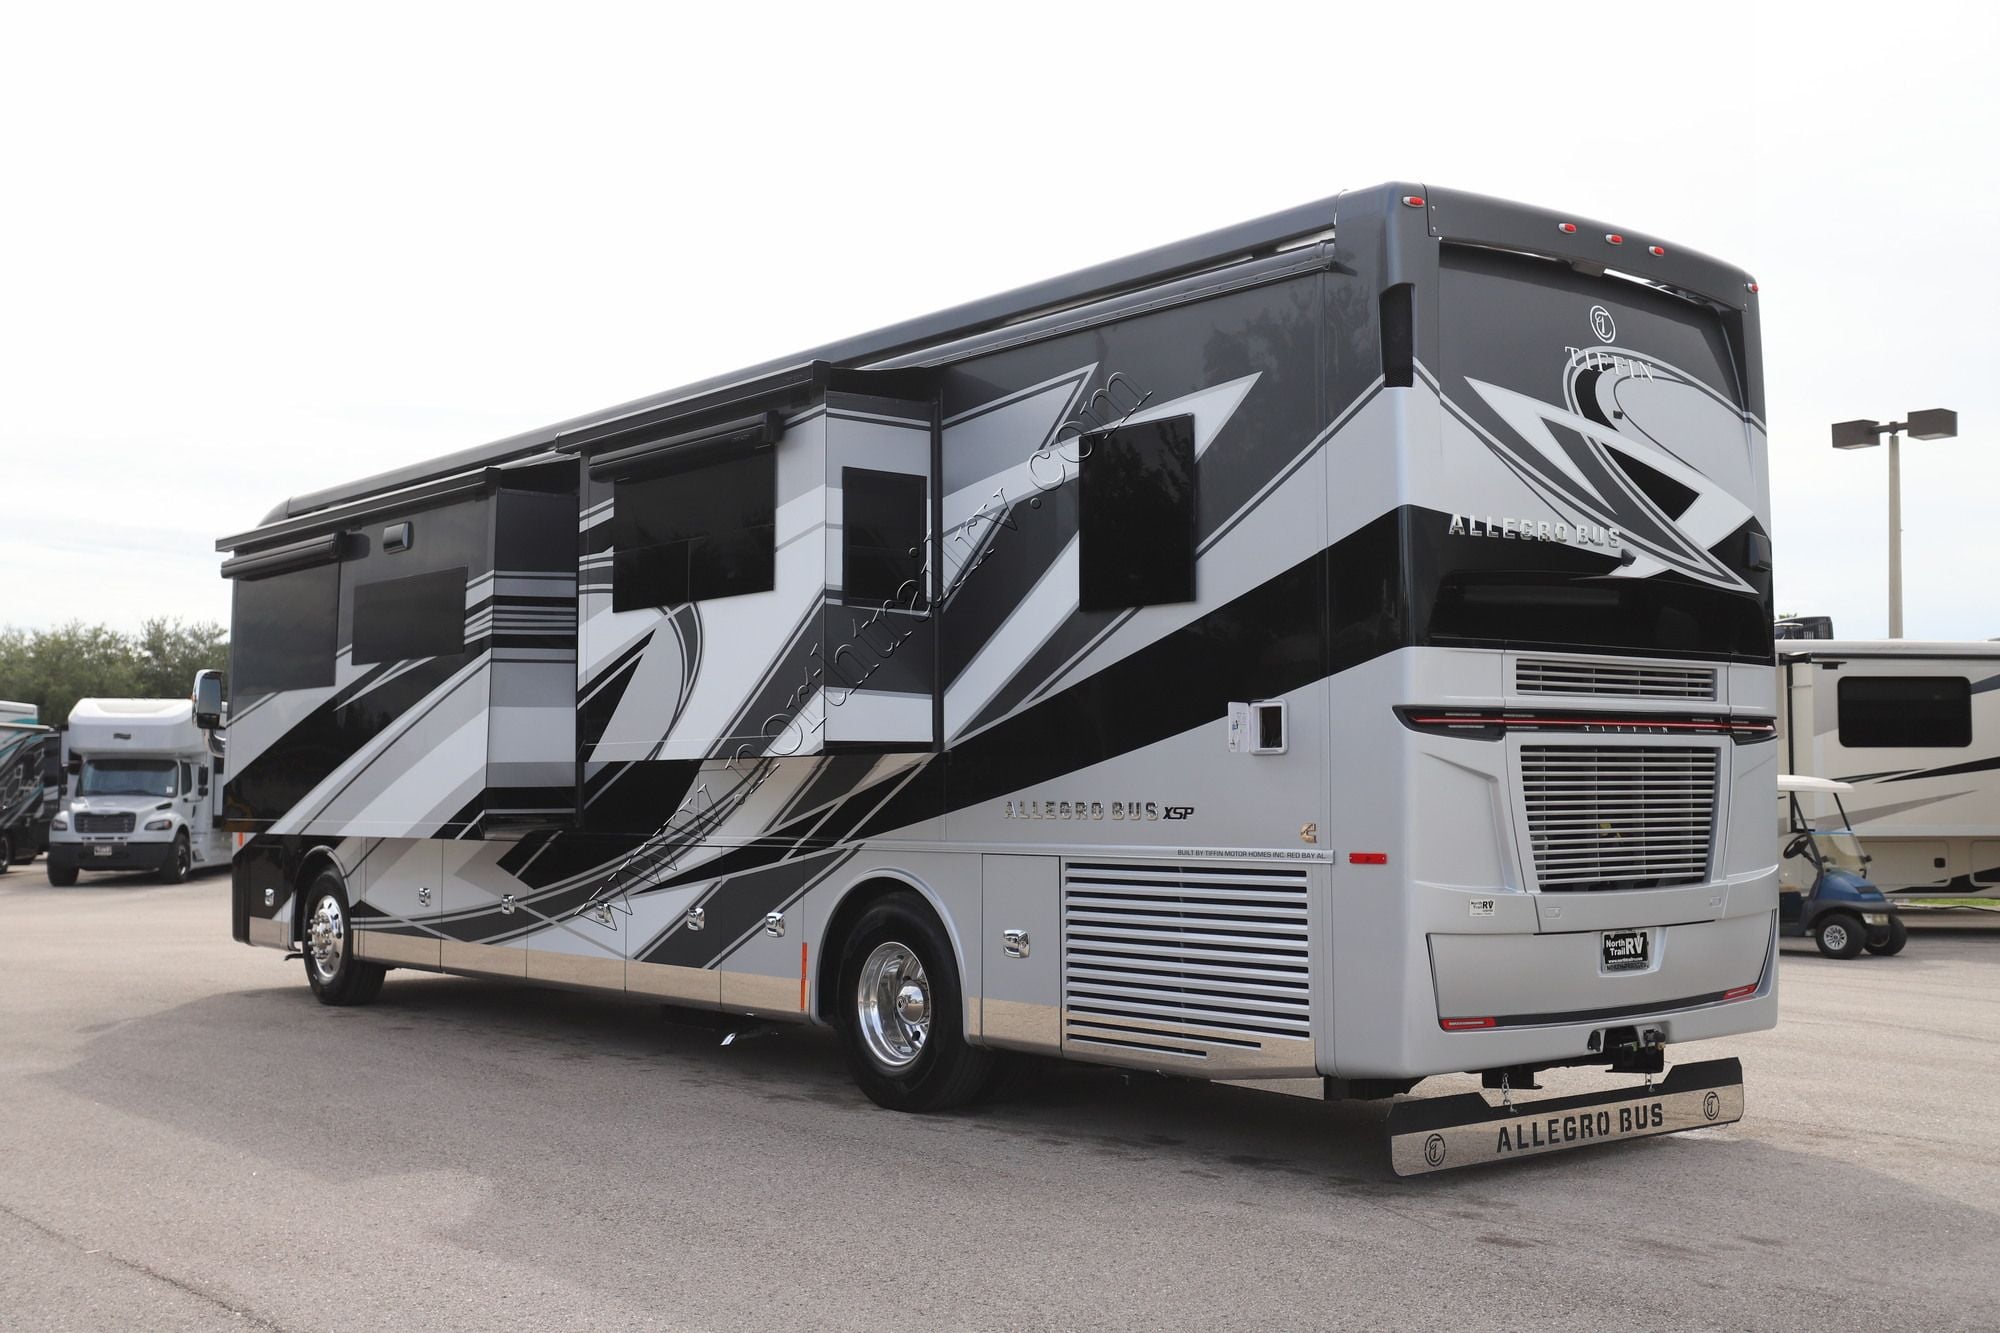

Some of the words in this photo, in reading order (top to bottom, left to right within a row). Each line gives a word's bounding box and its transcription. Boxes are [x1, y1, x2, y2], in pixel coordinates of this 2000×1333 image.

[1564, 346, 1655, 384] TIFFIN
[1448, 513, 1568, 543] ALLEGRO
[1576, 523, 1622, 549] BUS
[1003, 800, 1105, 821] ALLEGRO
[1111, 801, 1159, 821] BUS
[1162, 806, 1196, 820] XSP
[1195, 849, 1204, 857] BY
[1286, 851, 1301, 859] RED
[1301, 852, 1315, 860] BAY
[1605, 938, 1626, 948] North
[1625, 936, 1644, 955] RV
[1609, 947, 1626, 956] Trail
[1496, 1111, 1610, 1153] ALLEGRO
[1619, 1102, 1663, 1133] BUS
